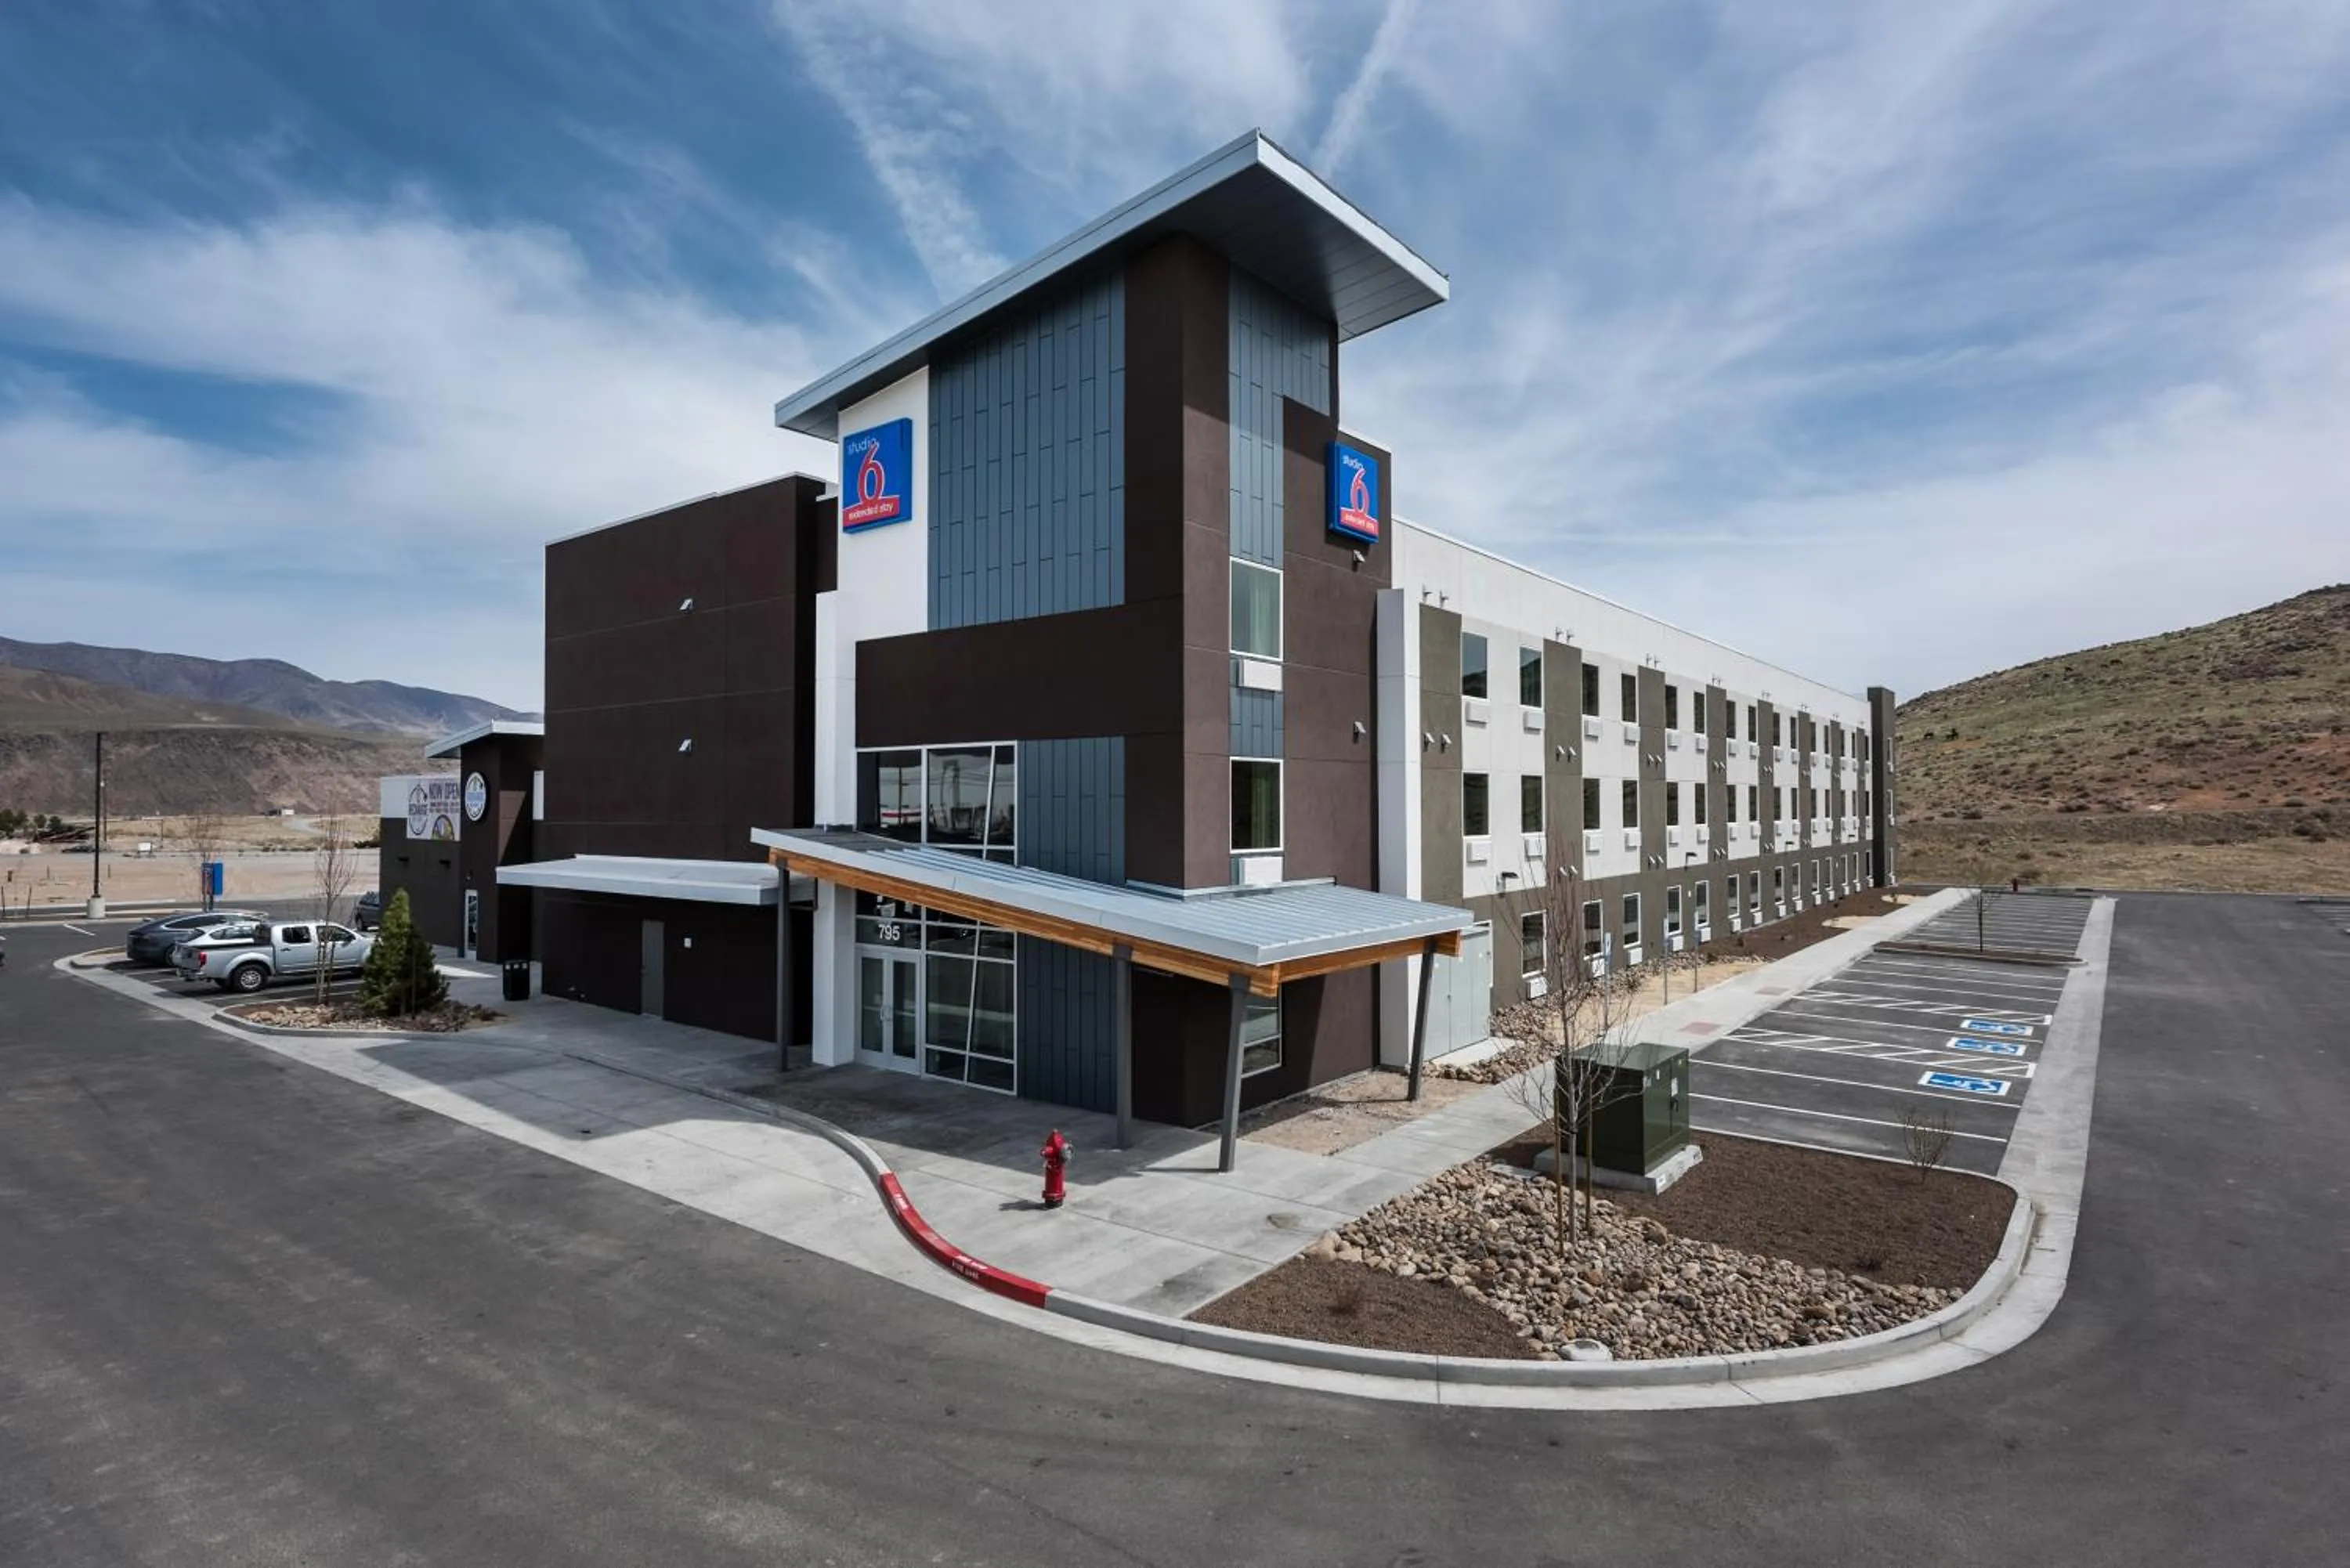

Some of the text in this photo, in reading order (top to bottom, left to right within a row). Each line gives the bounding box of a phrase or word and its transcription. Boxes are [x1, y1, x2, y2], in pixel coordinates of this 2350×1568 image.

[858, 444, 885, 503] 6
[1350, 468, 1369, 515] 6
[878, 924, 900, 940] 795
